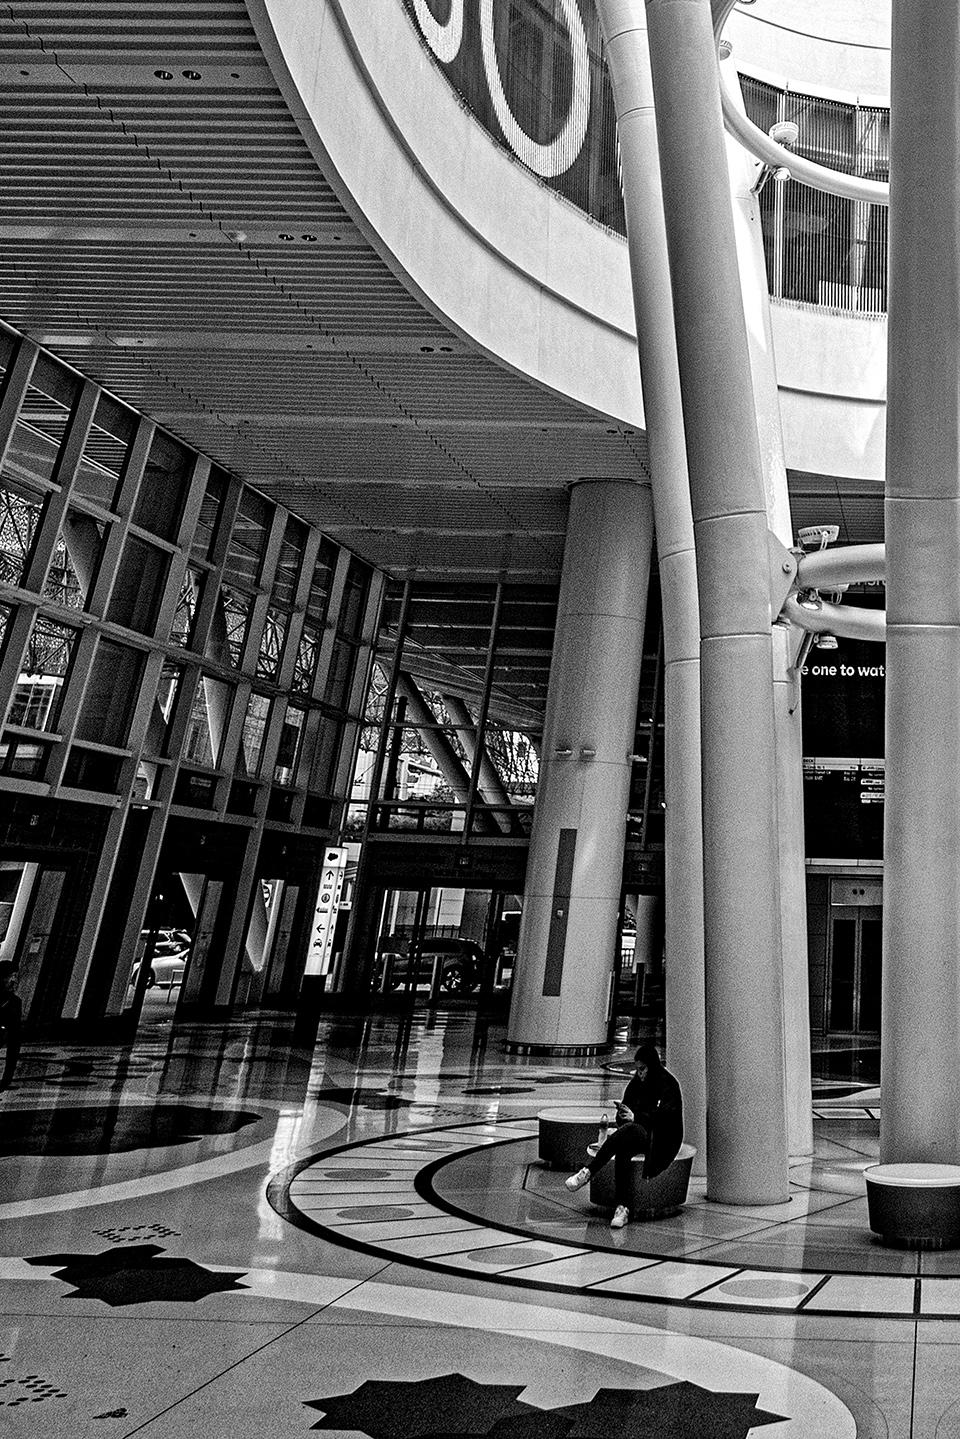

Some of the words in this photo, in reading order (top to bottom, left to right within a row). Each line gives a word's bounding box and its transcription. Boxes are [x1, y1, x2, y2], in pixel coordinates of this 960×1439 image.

[801, 665, 809, 675] e
[811, 665, 837, 676] one
[840, 663, 855, 676] to
[857, 664, 886, 677] wat
